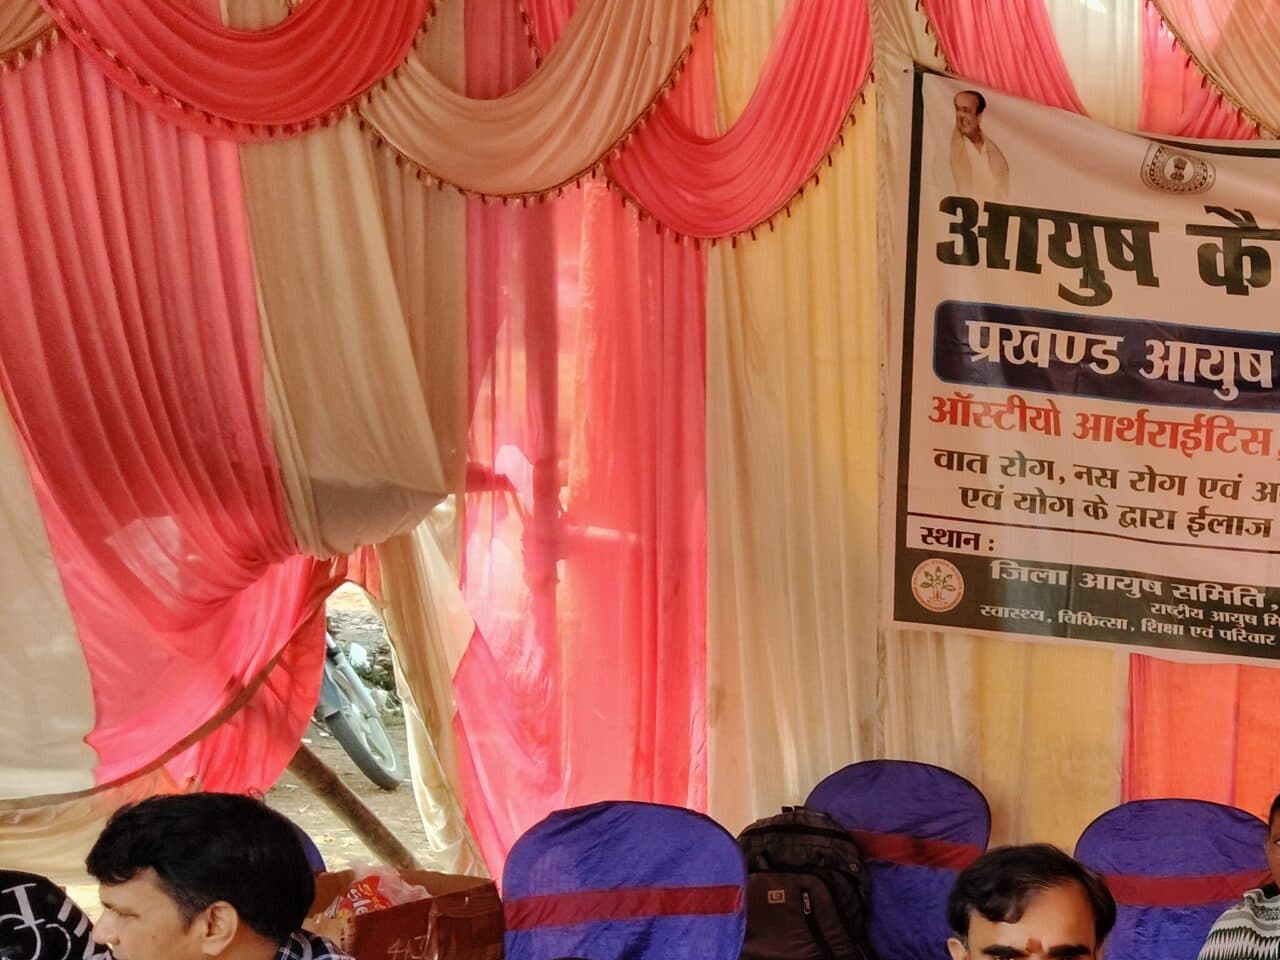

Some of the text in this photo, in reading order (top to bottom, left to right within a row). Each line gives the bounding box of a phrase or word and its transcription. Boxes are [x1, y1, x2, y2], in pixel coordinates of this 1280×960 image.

[936, 196, 1160, 306] आयुष
[965, 320, 1124, 375] प्रखण्ड
[1138, 339, 1274, 401] आयुष
[928, 391, 1061, 437] ऑस्टीयो
[933, 448, 990, 475] वात
[999, 450, 1065, 486] रोग,
[1074, 464, 1119, 490] नस
[1128, 464, 1187, 497] रोग
[1197, 472, 1245, 501] एवं
[958, 484, 1006, 511] एवं
[1012, 486, 1074, 518] योग
[1082, 494, 1109, 521] के
[1117, 504, 1177, 531] द्वारा
[1186, 506, 1274, 539] ईलाज
[919, 527, 981, 552] स्थान
[989, 559, 1069, 587] जिला
[1078, 572, 1163, 600] आयुष
[1170, 583, 1279, 611] समिति,
[1141, 617, 1184, 638] शिक्षा
[1190, 622, 1214, 641] एवं
[1218, 626, 1276, 646] परिवार
[1149, 602, 1204, 625] राष्ट्रीय
[1209, 609, 1260, 629] आयुष
